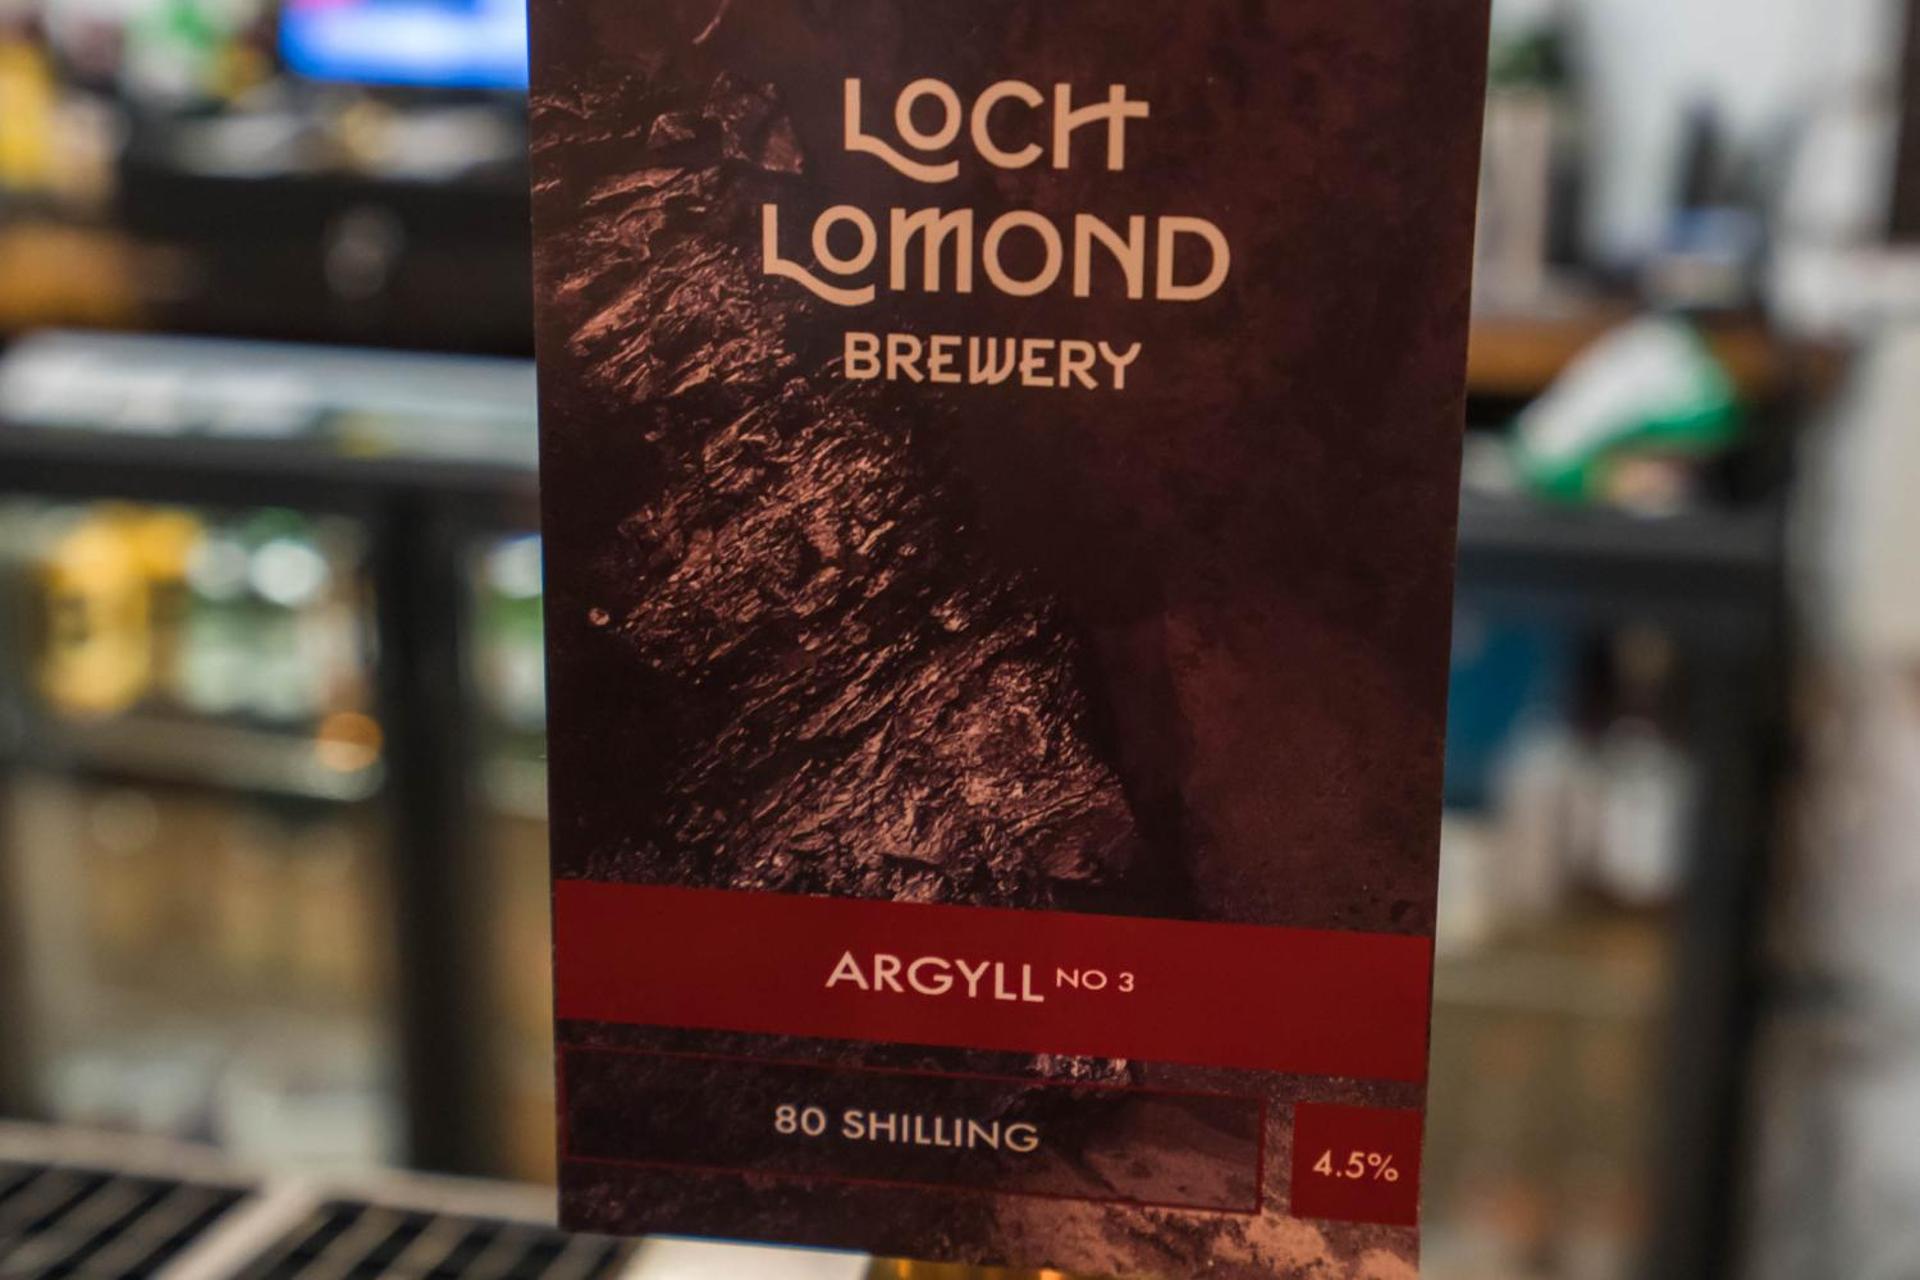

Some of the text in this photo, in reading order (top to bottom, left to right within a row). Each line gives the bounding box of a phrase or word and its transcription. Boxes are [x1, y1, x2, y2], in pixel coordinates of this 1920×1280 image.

[844, 77, 1149, 183] LOCH
[762, 203, 1231, 306] LOMOND
[844, 331, 1142, 390] BREWERY
[825, 950, 1135, 1003] ARGYLL NO 3
[774, 1105, 1040, 1153] 80 SHILLING
[1312, 1149, 1399, 1182] 4.5%
